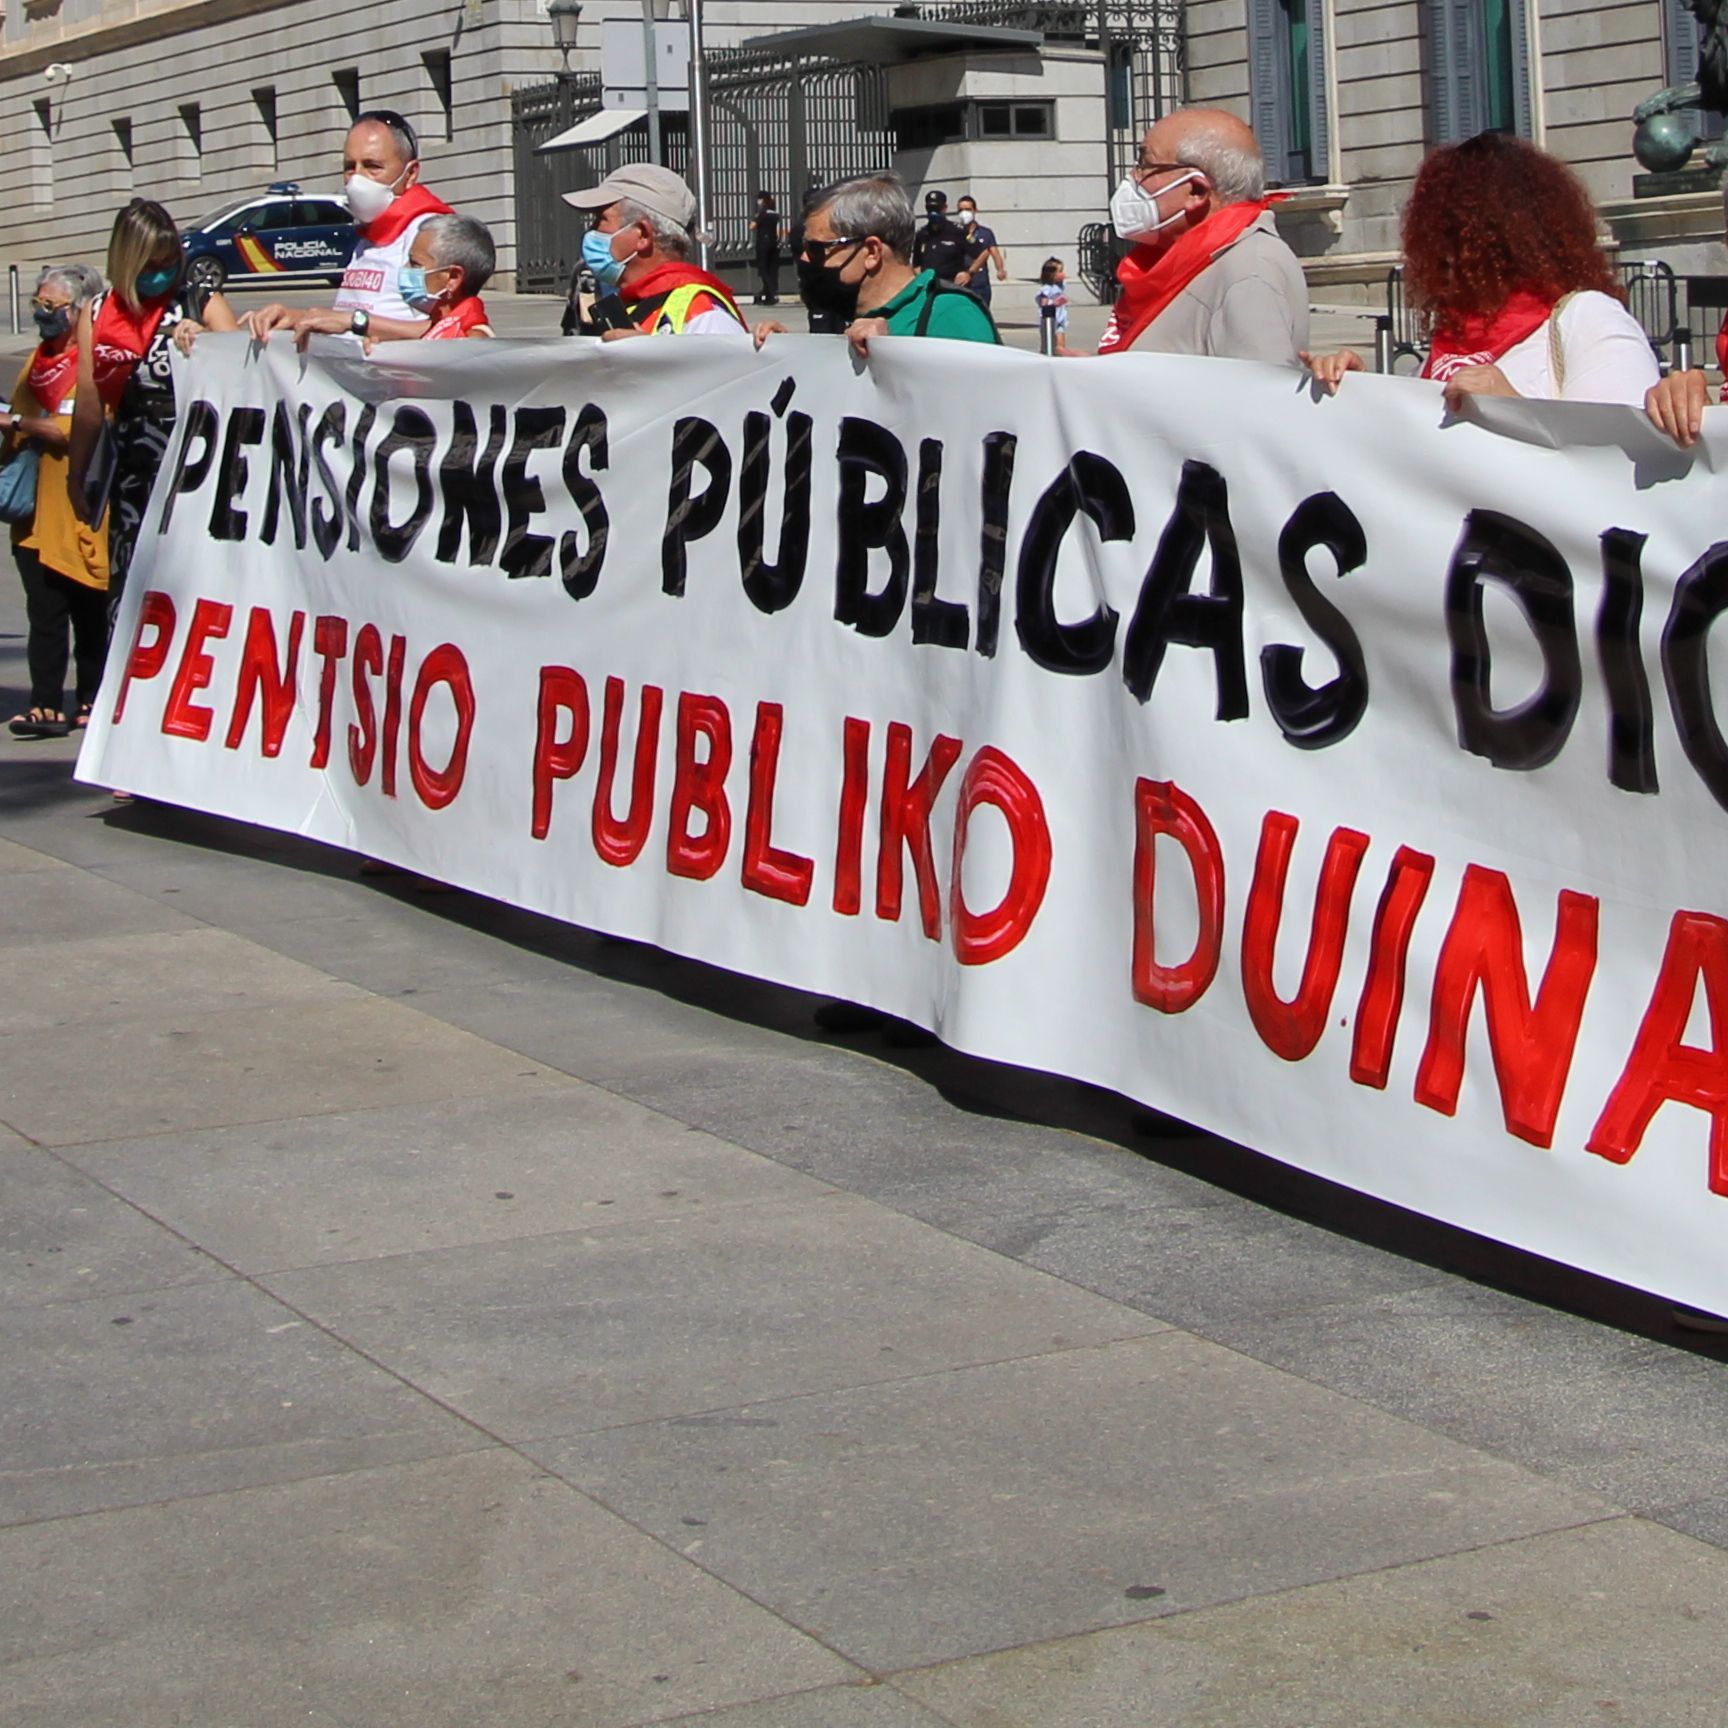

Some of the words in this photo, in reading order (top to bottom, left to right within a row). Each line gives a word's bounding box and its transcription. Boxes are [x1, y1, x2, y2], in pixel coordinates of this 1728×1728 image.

[274, 249, 344, 259] NACIONAL
[158, 399, 610, 601] PENSIONES
[661, 379, 1369, 751] PÚBLICAS
[114, 596, 476, 810] PENTSIO
[533, 665, 1054, 966] PUBLIKO
